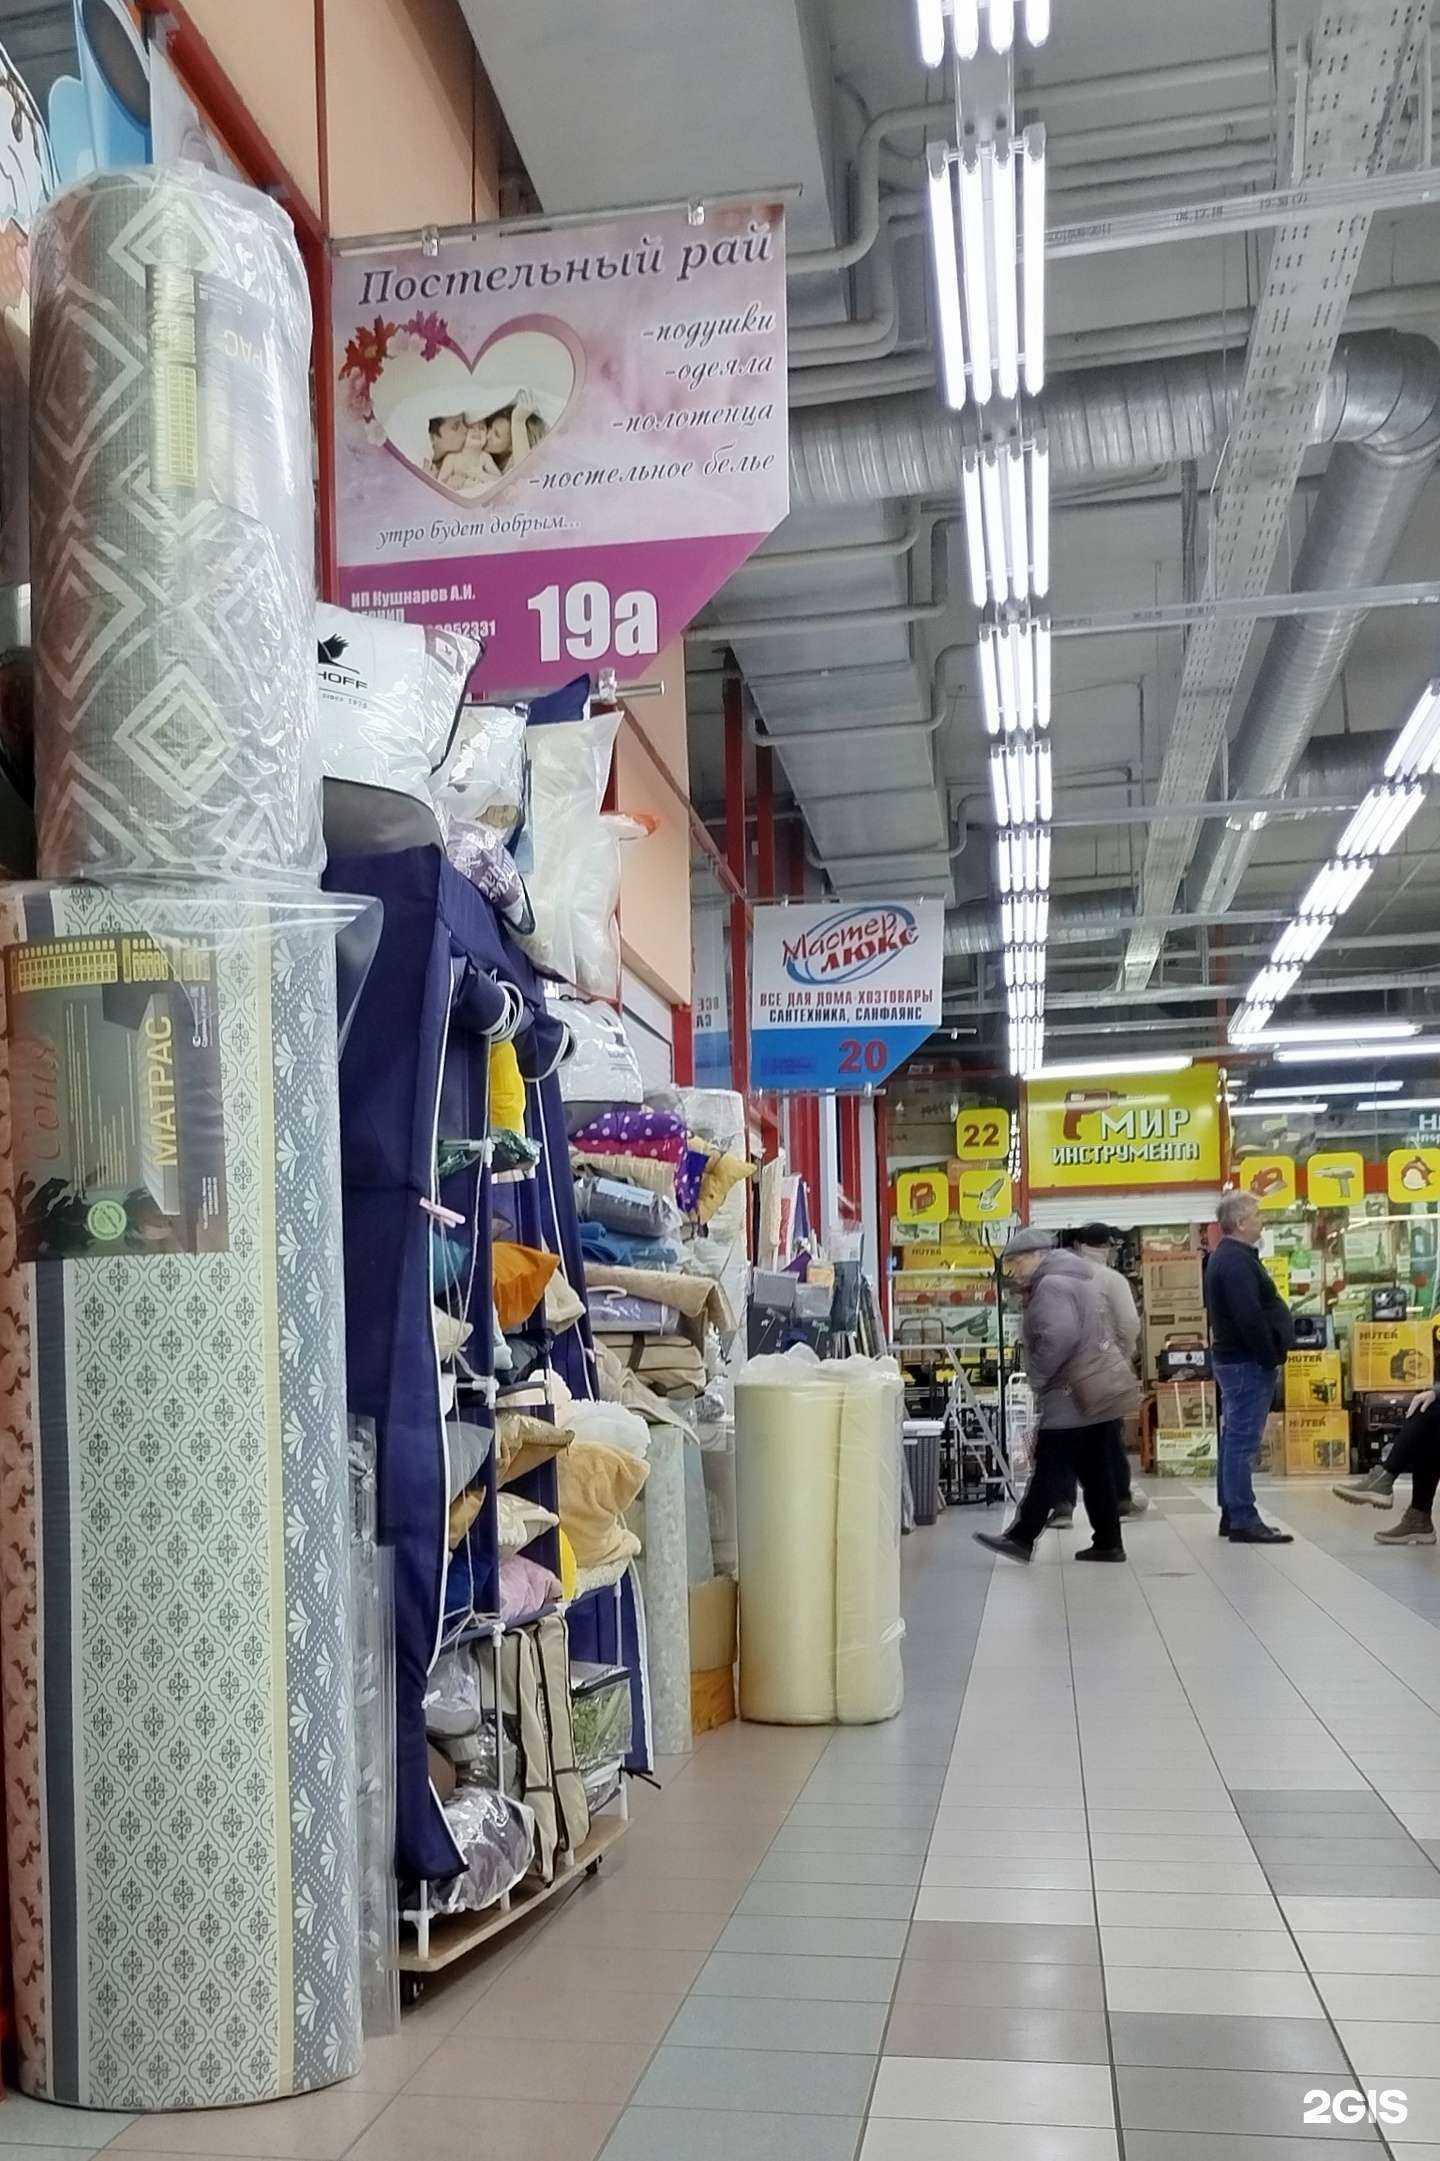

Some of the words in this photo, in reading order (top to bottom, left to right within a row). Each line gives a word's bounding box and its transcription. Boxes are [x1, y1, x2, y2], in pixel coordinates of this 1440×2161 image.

[358, 237, 662, 304] Постельный
[676, 224, 771, 281] рай
[643, 303, 773, 349] -подушки
[665, 356, 773, 390] -одеяла
[613, 404, 773, 432] -полотенца
[529, 461, 694, 489] -постельное
[704, 443, 775, 476] белье
[376, 528, 424, 549] утро
[430, 520, 484, 543] будет
[351, 592, 370, 607] ИП
[450, 584, 476, 601] А.И.
[527, 580, 658, 663] 19а
[783, 912, 897, 967] Мастер
[760, 993, 782, 1007] ВСЕ
[787, 992, 811, 1008] ДЛЯ
[816, 991, 852, 1008] ДОМА
[858, 989, 933, 1005] ХОЗТОВАРЫ
[769, 1007, 850, 1023] САНТЕХНИКА,
[856, 1006, 922, 1021] САНФАЯНС
[839, 1039, 888, 1074] 20
[145, 1015, 178, 1166] МАТРАС
[963, 1122, 1000, 1148] 22
[1101, 1108, 1190, 1141] МИР
[1052, 1141, 1200, 1166] ИНСТРУМЕНТА
